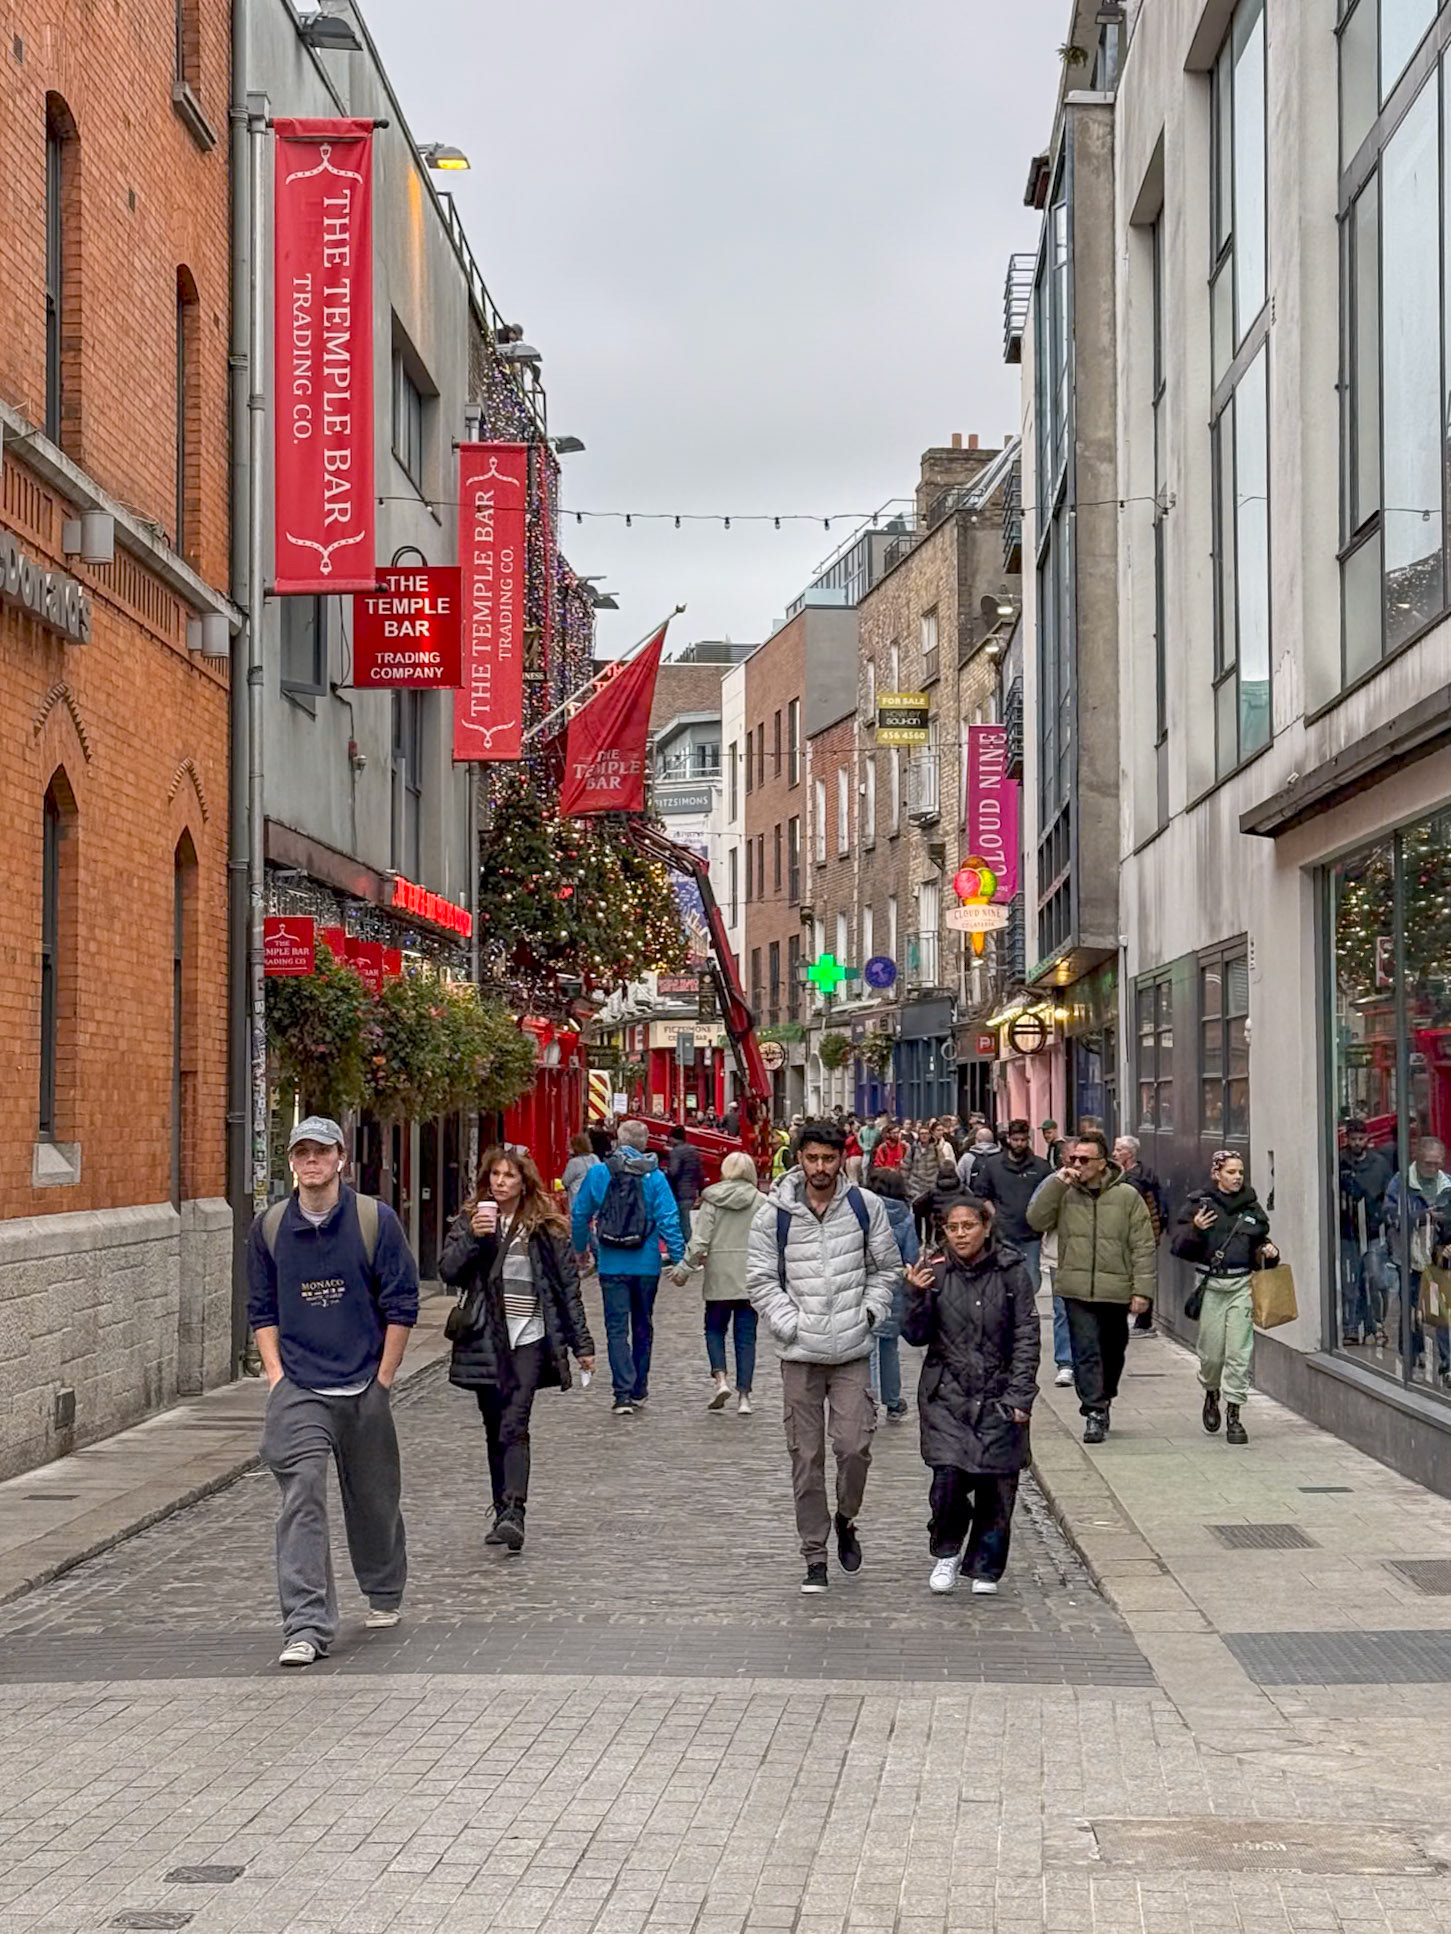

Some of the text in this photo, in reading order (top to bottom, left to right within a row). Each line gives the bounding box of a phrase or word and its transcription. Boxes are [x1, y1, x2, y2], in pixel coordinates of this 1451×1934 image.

[292, 273, 312, 445] TRADING CO.
[322, 188, 352, 528] THE TEMPLE BAR
[0, 531, 91, 646] Donald's
[386, 575, 429, 592] THE
[364, 597, 451, 615] TEMPLE
[470, 490, 495, 717] THE TEMPLE BAR
[498, 578, 513, 661] TRADING
[384, 620, 431, 637] BAR
[375, 651, 441, 664] TRADING
[370, 666, 444, 679] COMPANY
[882, 697, 926, 705] FOR SALE
[979, 732, 1008, 790] NINE
[586, 775, 623, 790] BAR
[979, 798, 1008, 877] CLOUD
[954, 909, 1001, 920] CLOUD NINE
[291, 947, 310, 956] BAR
[301, 1279, 345, 1290] MONACO
